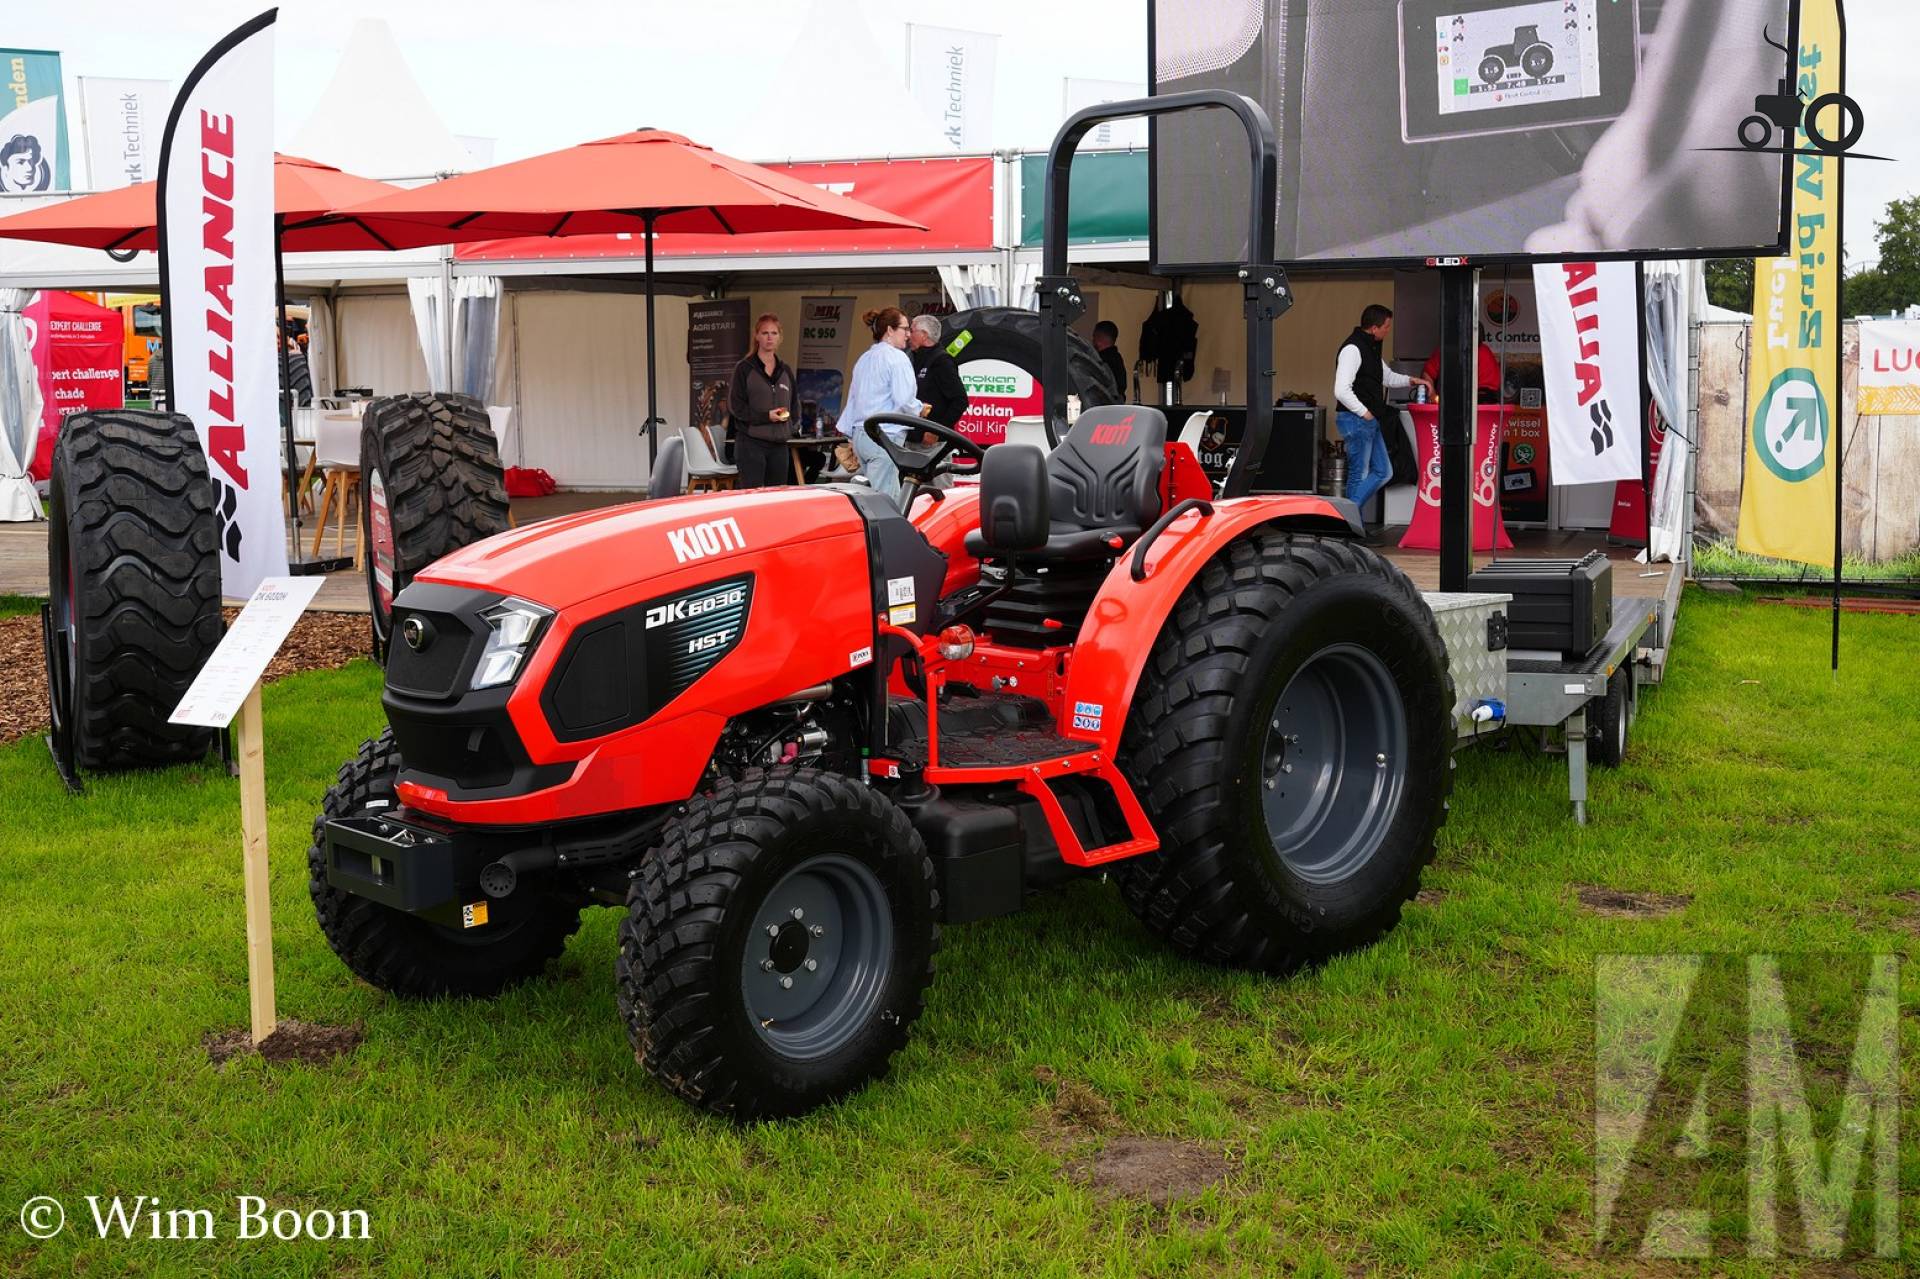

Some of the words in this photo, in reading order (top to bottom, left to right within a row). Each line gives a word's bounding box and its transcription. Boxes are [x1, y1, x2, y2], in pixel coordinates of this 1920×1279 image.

[944, 45, 964, 121] Techniek
[120, 93, 140, 160] Techniek
[200, 108, 249, 492] ALLIANCE
[50, 321, 71, 332] EXPERT
[72, 321, 102, 332] CHALLENGE
[817, 327, 836, 339] 950
[72, 368, 120, 381] challenge
[962, 375, 1016, 383] nokian
[964, 384, 1016, 393] TYRES
[958, 420, 983, 433] Soil
[1521, 429, 1541, 438] box
[667, 516, 747, 564] KIOTI
[688, 629, 730, 654] HST
